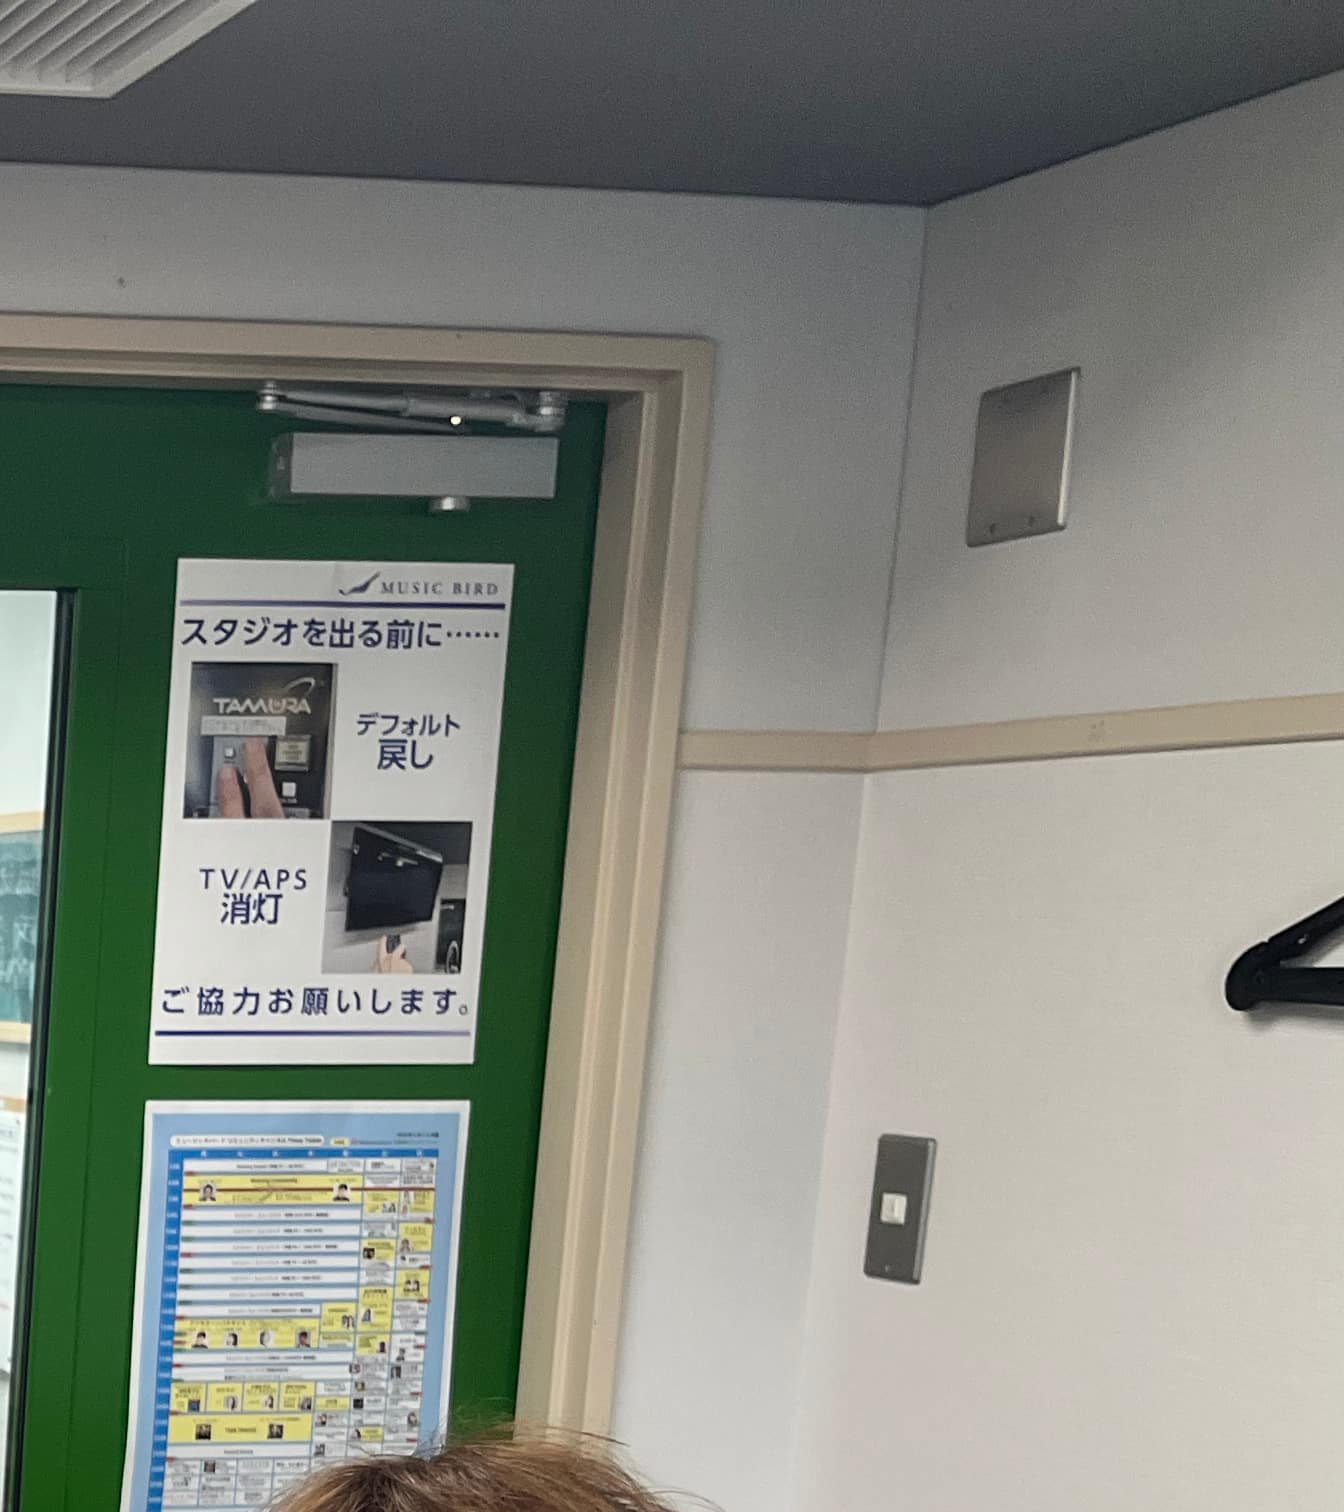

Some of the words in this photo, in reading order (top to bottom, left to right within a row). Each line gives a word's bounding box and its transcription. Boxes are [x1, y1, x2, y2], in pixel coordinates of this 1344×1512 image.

[380, 581, 443, 595] MUSIC
[453, 582, 499, 596] BIRD
[213, 698, 311, 714] TAMURA
[357, 713, 460, 737] デフォルト
[377, 739, 434, 770] 戻し
[200, 867, 308, 891] TV/APS
[221, 893, 283, 925] 消灯
[162, 986, 469, 1017] ご協力お願いします。
